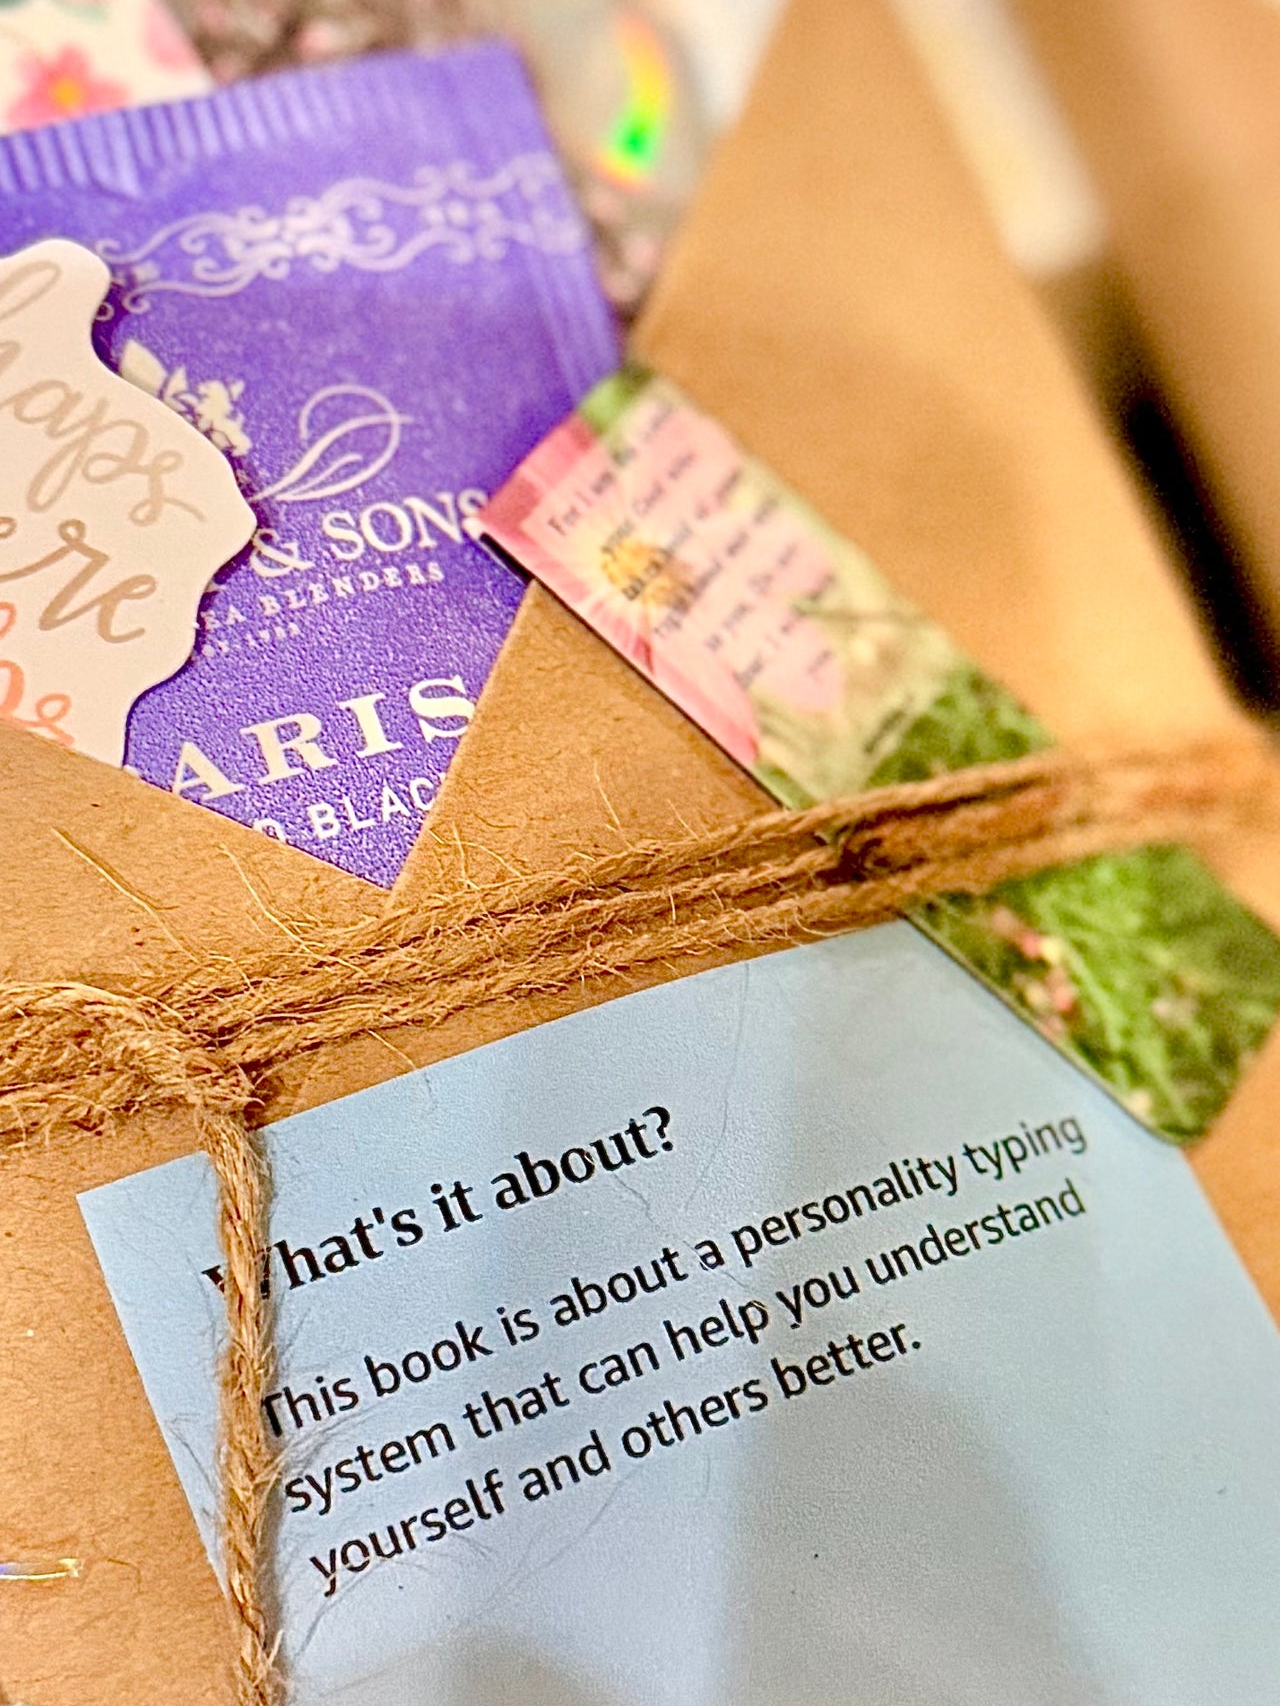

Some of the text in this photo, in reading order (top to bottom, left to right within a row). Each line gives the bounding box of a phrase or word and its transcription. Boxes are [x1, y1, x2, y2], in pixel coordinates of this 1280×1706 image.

[250, 488, 490, 578] & SONS
[200, 560, 445, 634] EA BLENDERS
[170, 676, 477, 801] ARIS
[307, 772, 446, 840] BLAC
[431, 1182, 483, 1233] it
[491, 1105, 675, 1211] about?
[261, 1115, 1088, 1438] This book is about a personality typing
[285, 1178, 1087, 1516] system that can help you understand
[309, 1323, 923, 1598] yourself and others better.
